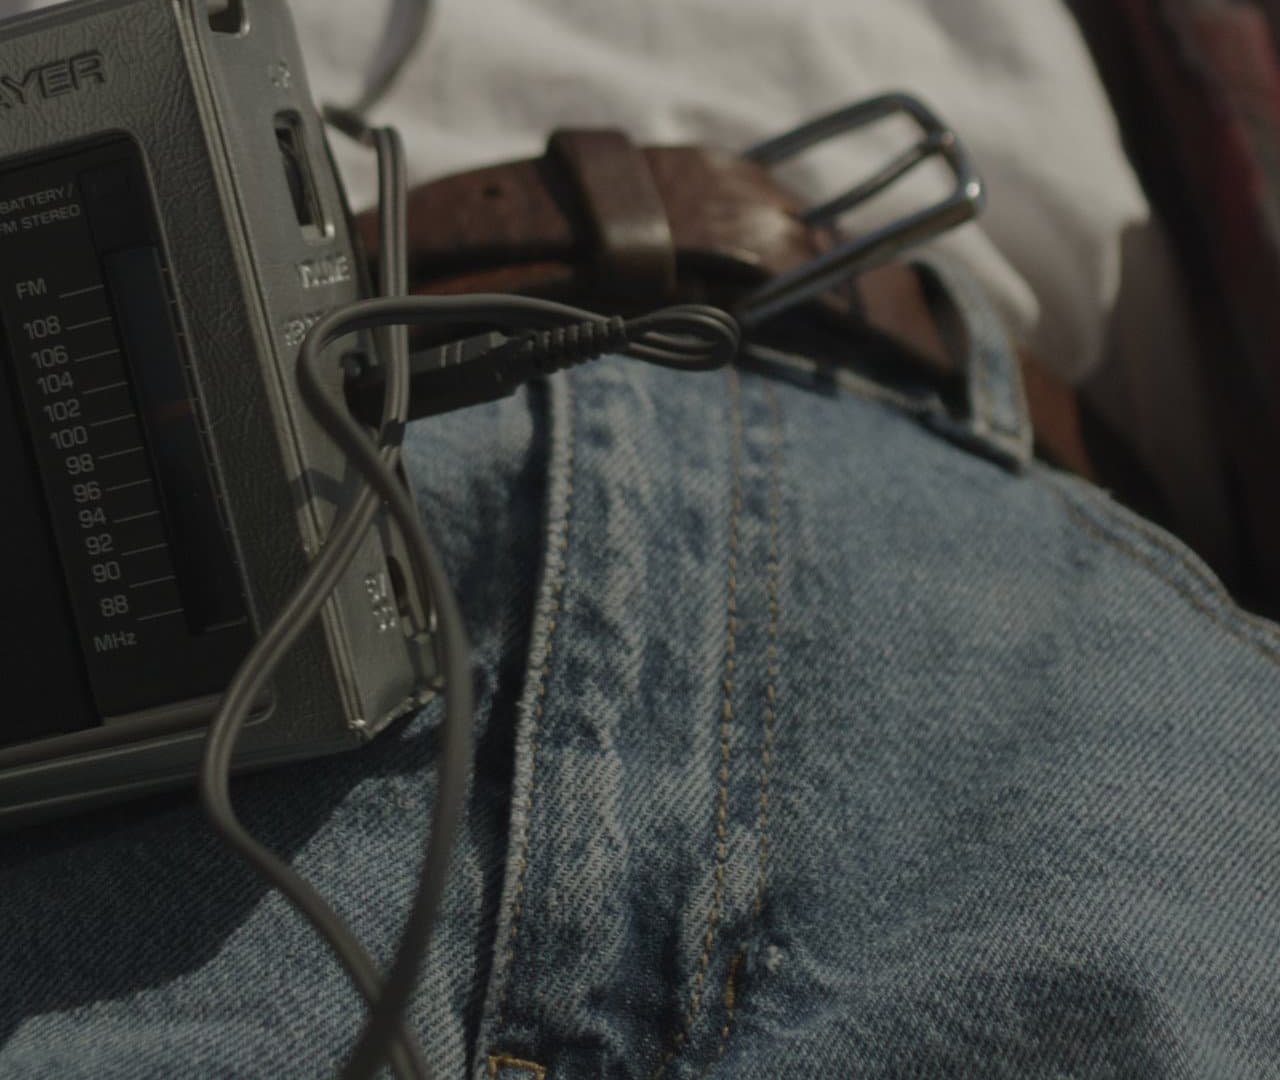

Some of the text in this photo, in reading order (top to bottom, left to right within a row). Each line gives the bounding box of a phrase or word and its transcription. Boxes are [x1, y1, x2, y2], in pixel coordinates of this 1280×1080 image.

[23, 203, 81, 230] STEREO
[16, 277, 48, 299] FM
[23, 315, 62, 340] 108
[30, 345, 69, 369] 106
[36, 371, 74, 395] 104
[43, 398, 82, 423] 102
[49, 425, 88, 449] 100
[65, 453, 95, 475] 98
[73, 481, 102, 503] 96
[78, 507, 107, 528] 94
[85, 533, 114, 556] 92
[92, 561, 121, 583] 90
[100, 594, 129, 617] 88
[93, 631, 137, 653] MHz
